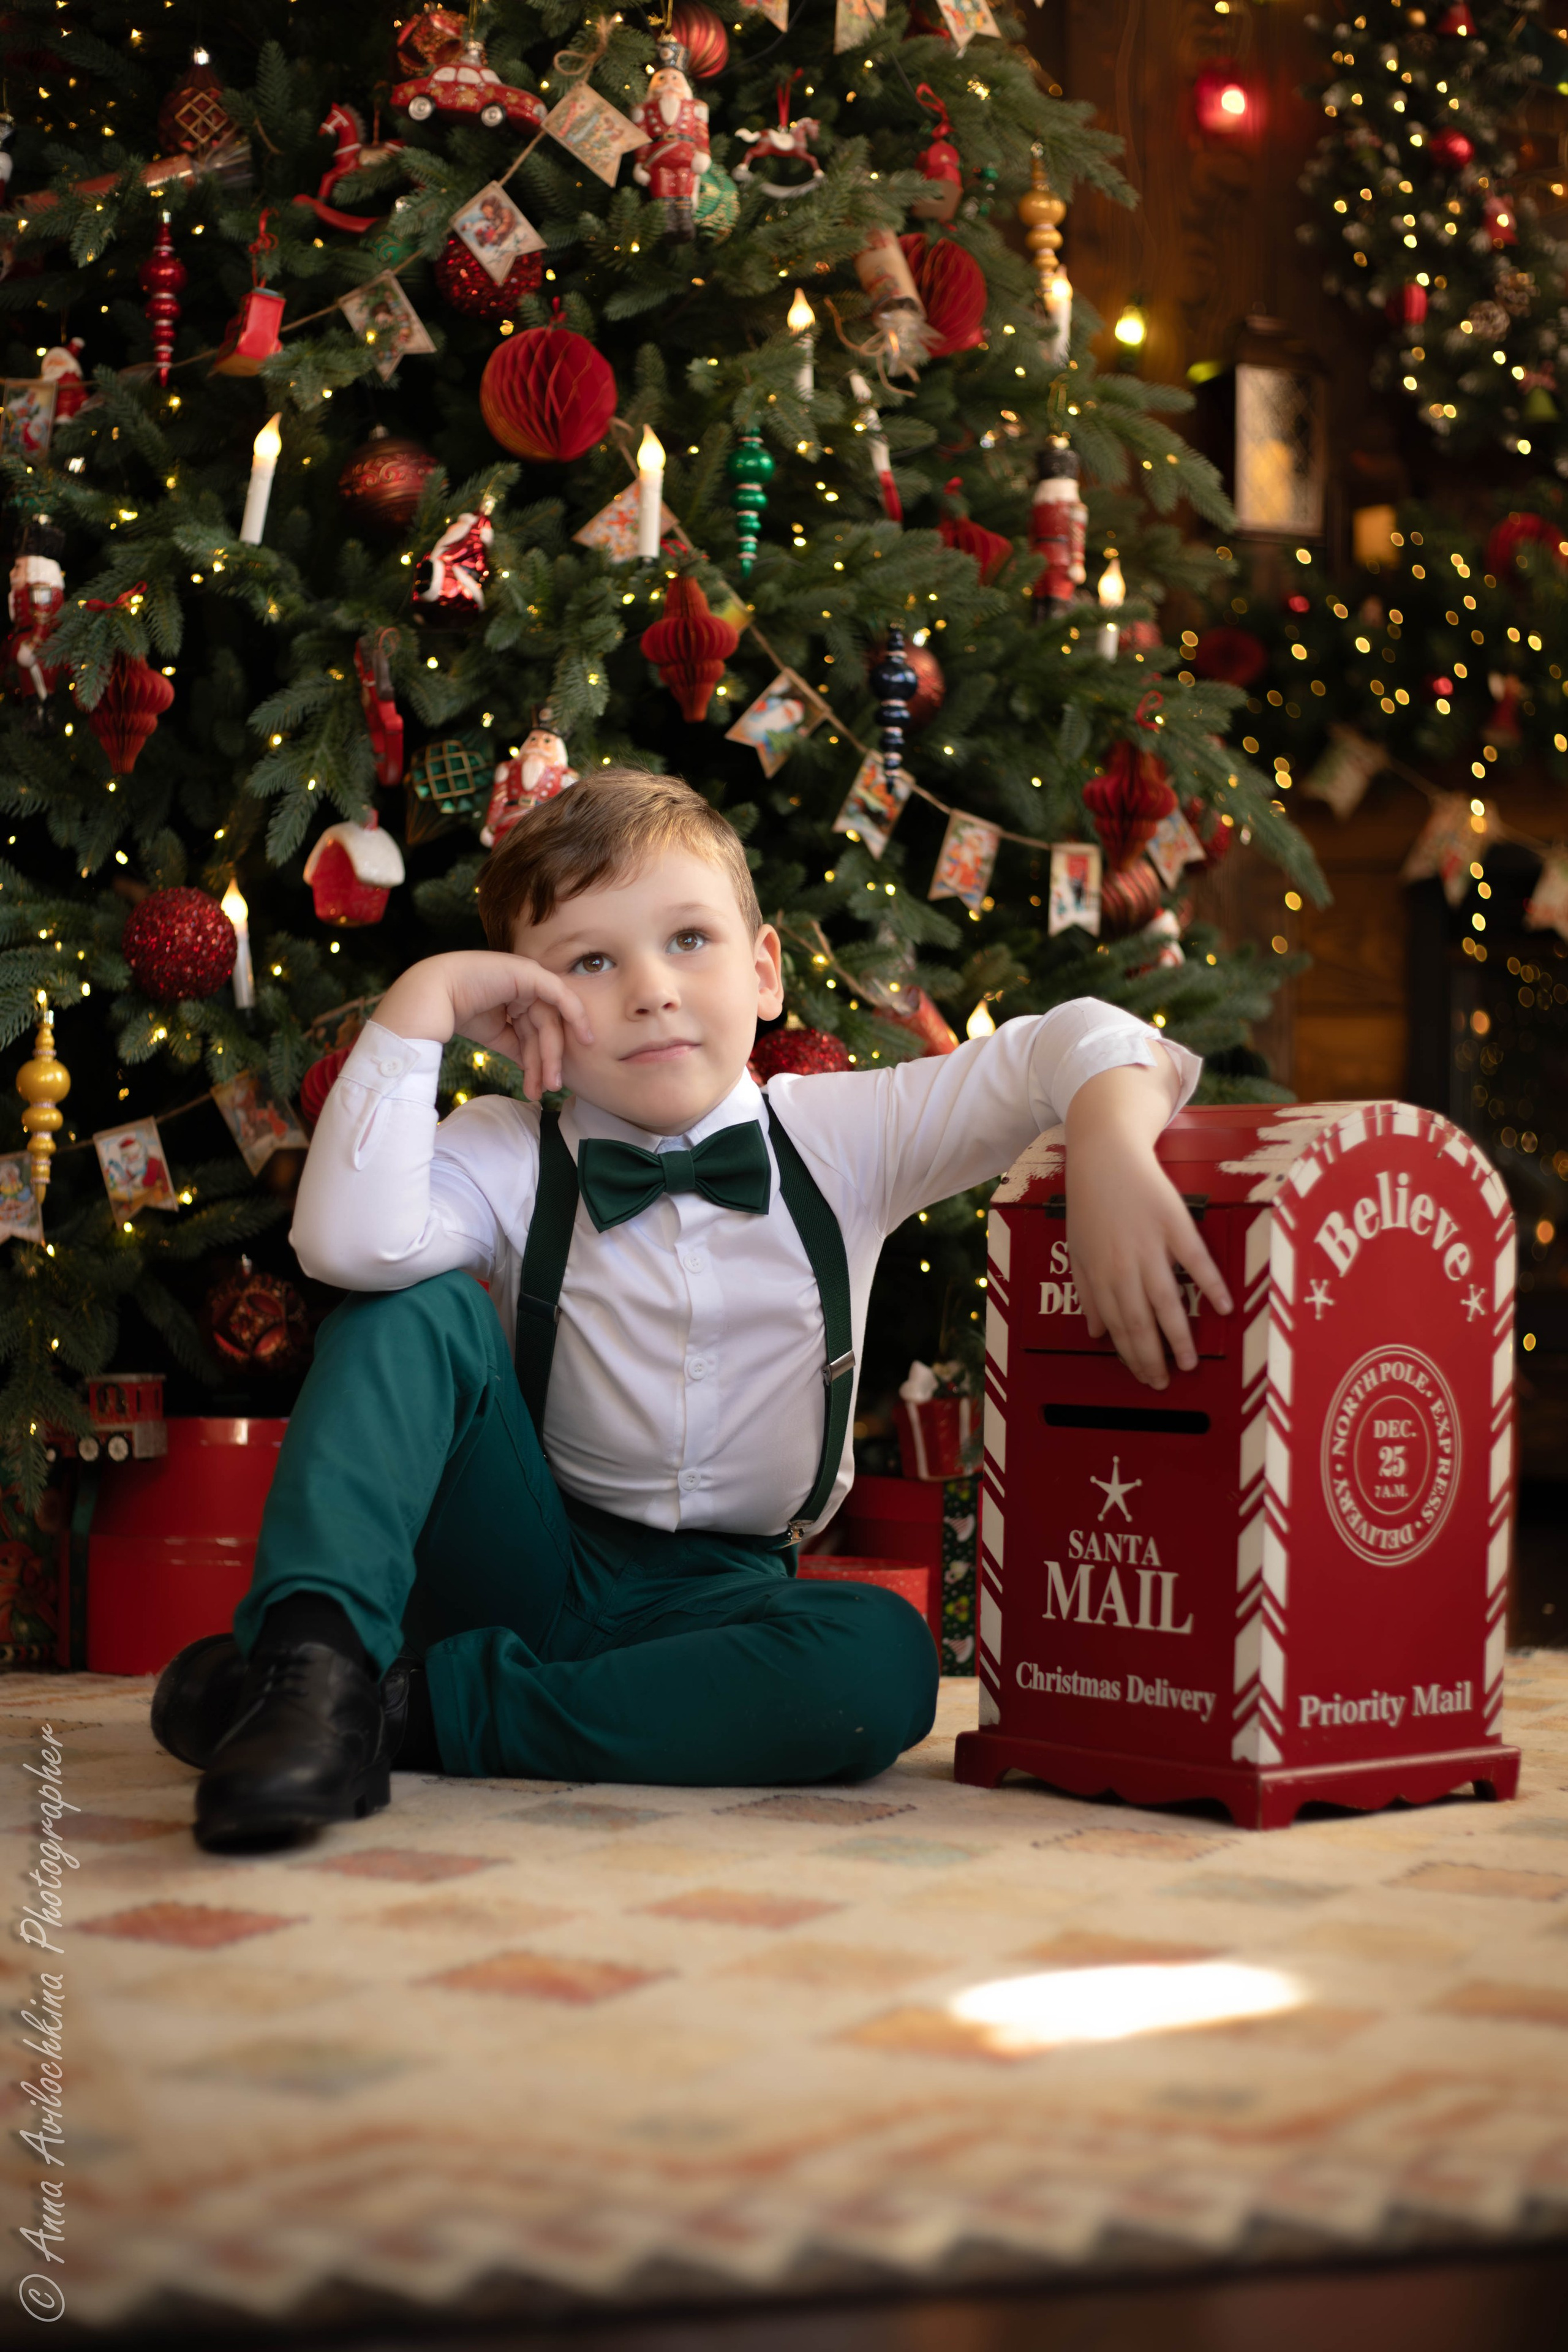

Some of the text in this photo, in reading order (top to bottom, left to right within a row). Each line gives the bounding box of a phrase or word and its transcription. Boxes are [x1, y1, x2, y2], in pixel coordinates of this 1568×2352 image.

[1314, 1171, 1471, 1281] Believe
[1332, 1368, 1379, 1457] NORTH
[1373, 1419, 1417, 1439] DEC.
[1378, 1446, 1406, 1477] 25
[1421, 1397, 1452, 1524] EXPRESS
[1332, 1477, 1414, 1549] DELIVERY
[1068, 1529, 1162, 1566] SANTA
[1041, 1560, 1194, 1634] MAIL
[1016, 1661, 1217, 1723] Christmas Delivery
[1298, 1681, 1472, 1728] Priority Mail
